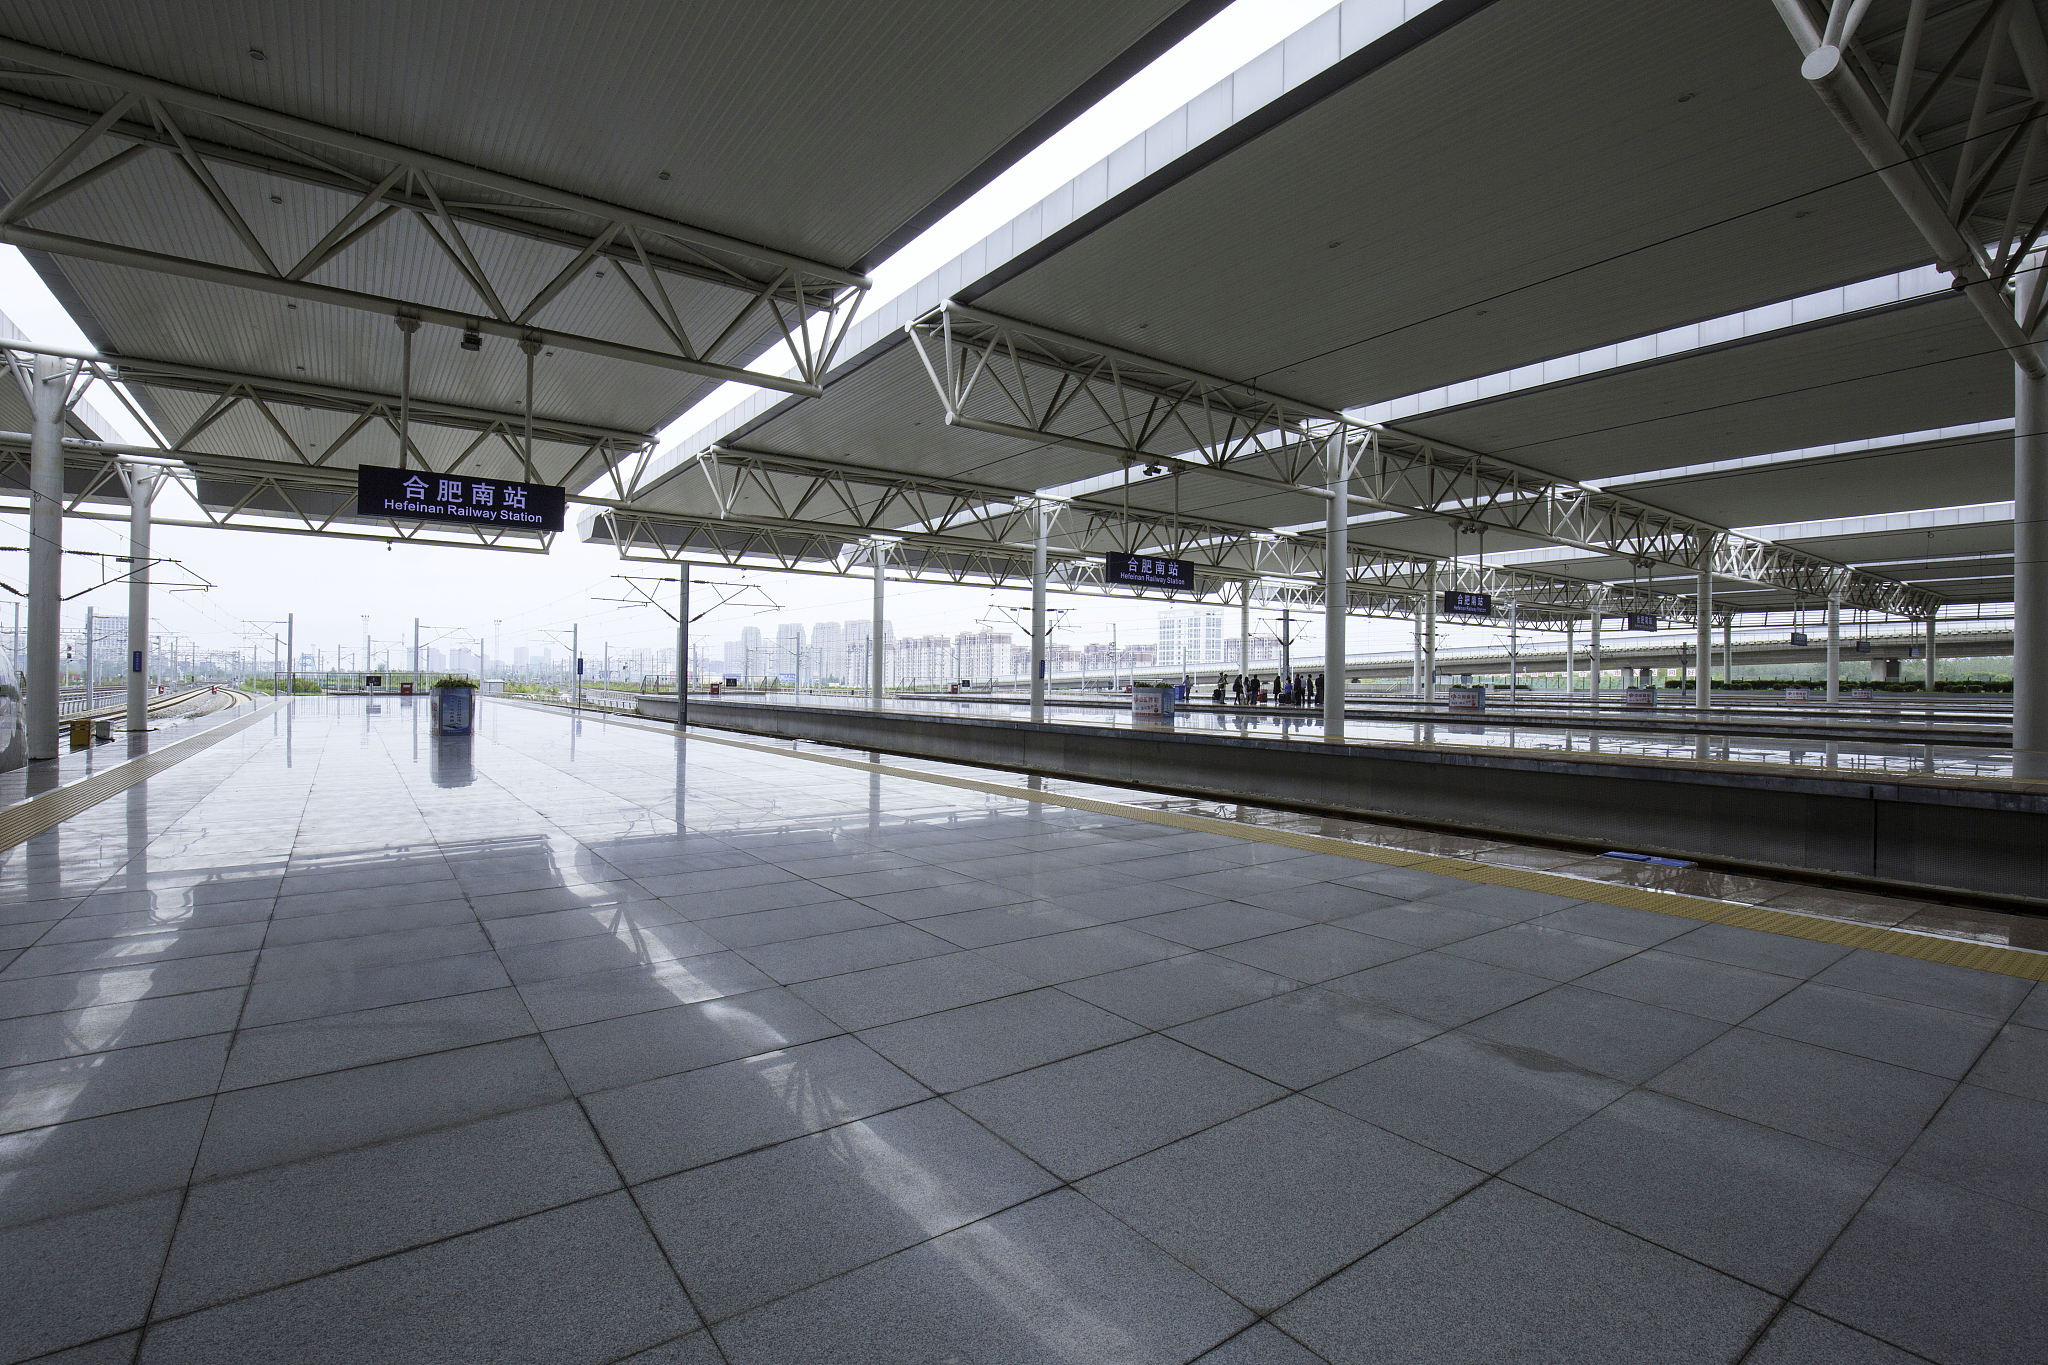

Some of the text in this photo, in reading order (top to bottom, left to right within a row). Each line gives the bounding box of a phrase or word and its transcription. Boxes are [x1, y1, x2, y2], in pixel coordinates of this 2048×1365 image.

[403, 475, 528, 510] 合肥南站
[384, 499, 543, 523] Hefeinan Railway Station
[1127, 557, 1179, 577] 合肥南站
[1120, 572, 1185, 585] Hefeinan Railway Station
